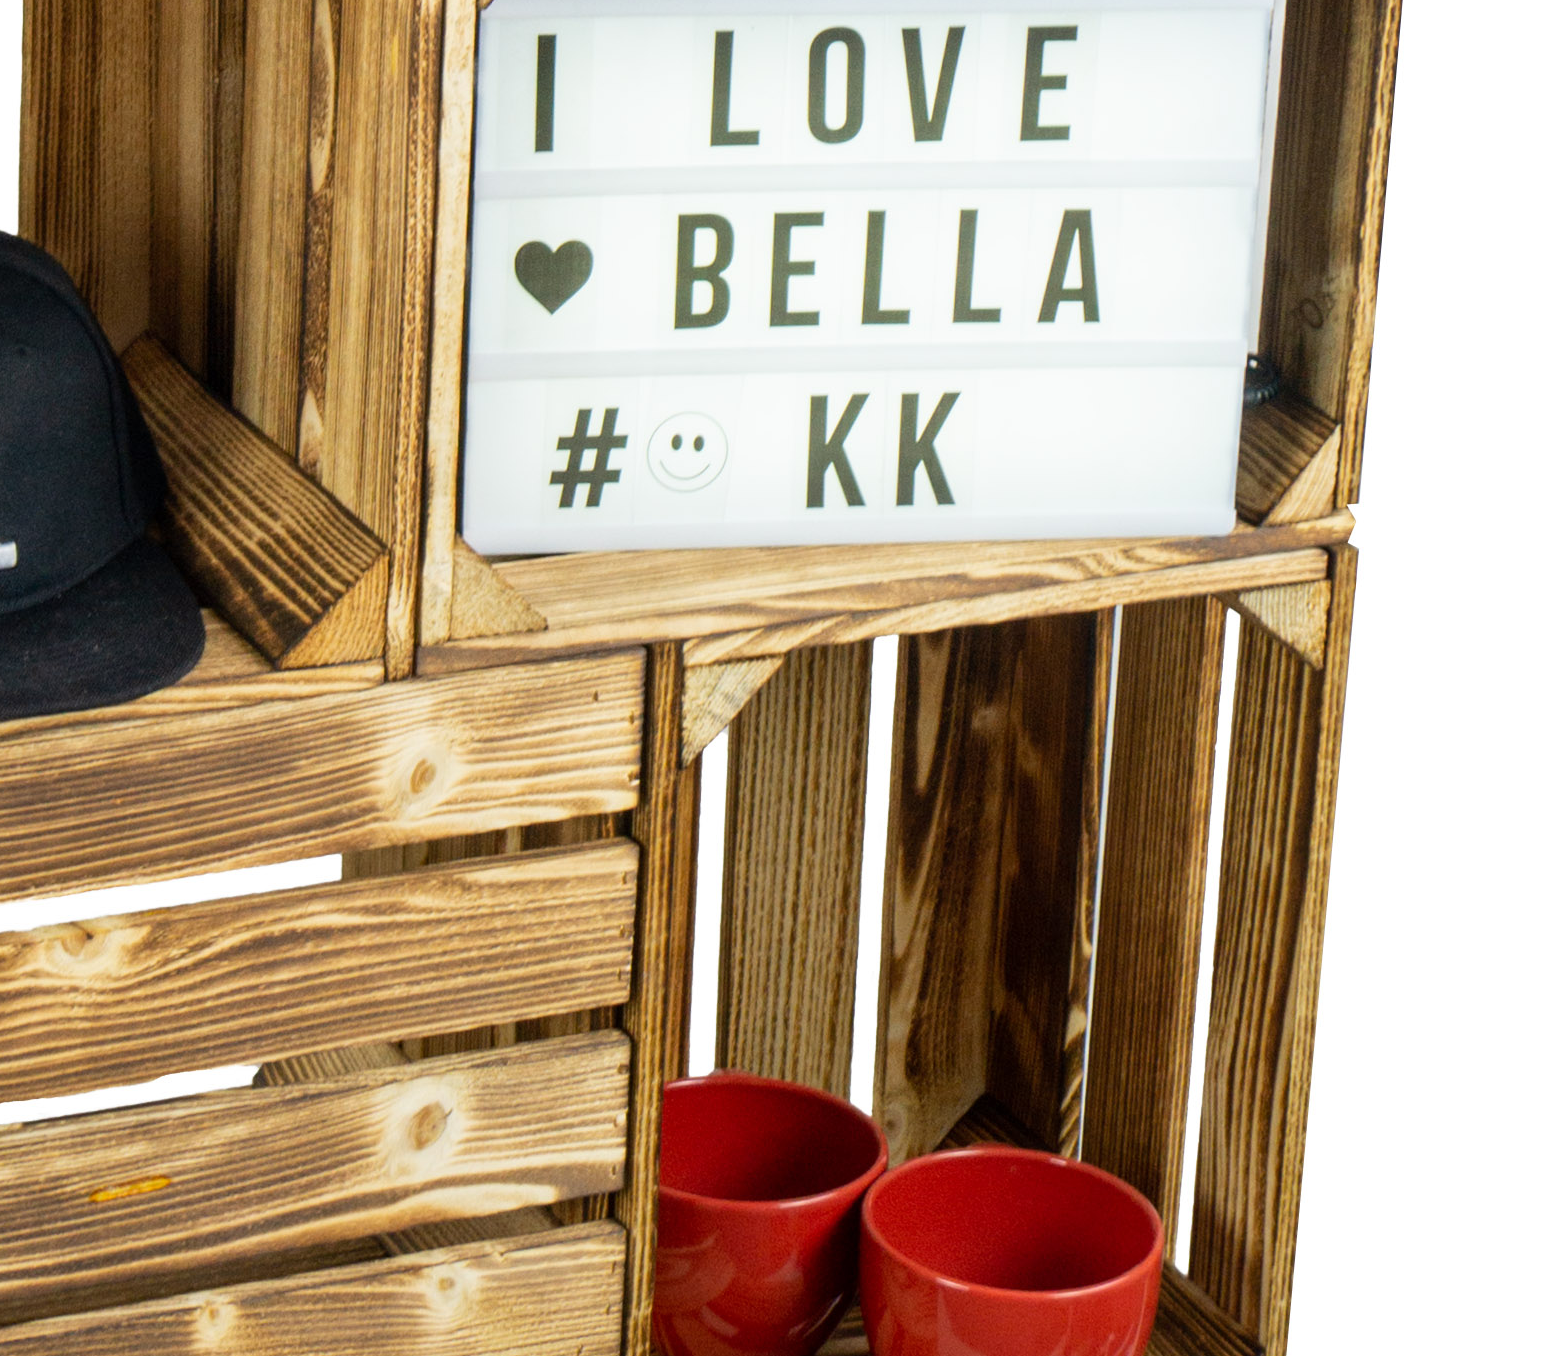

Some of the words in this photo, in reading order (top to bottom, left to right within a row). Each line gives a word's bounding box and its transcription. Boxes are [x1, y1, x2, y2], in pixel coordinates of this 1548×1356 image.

[534, 33, 558, 153] I
[709, 25, 1080, 149] LOVE
[673, 208, 1102, 331] BELLA
[805, 391, 962, 510] KK
